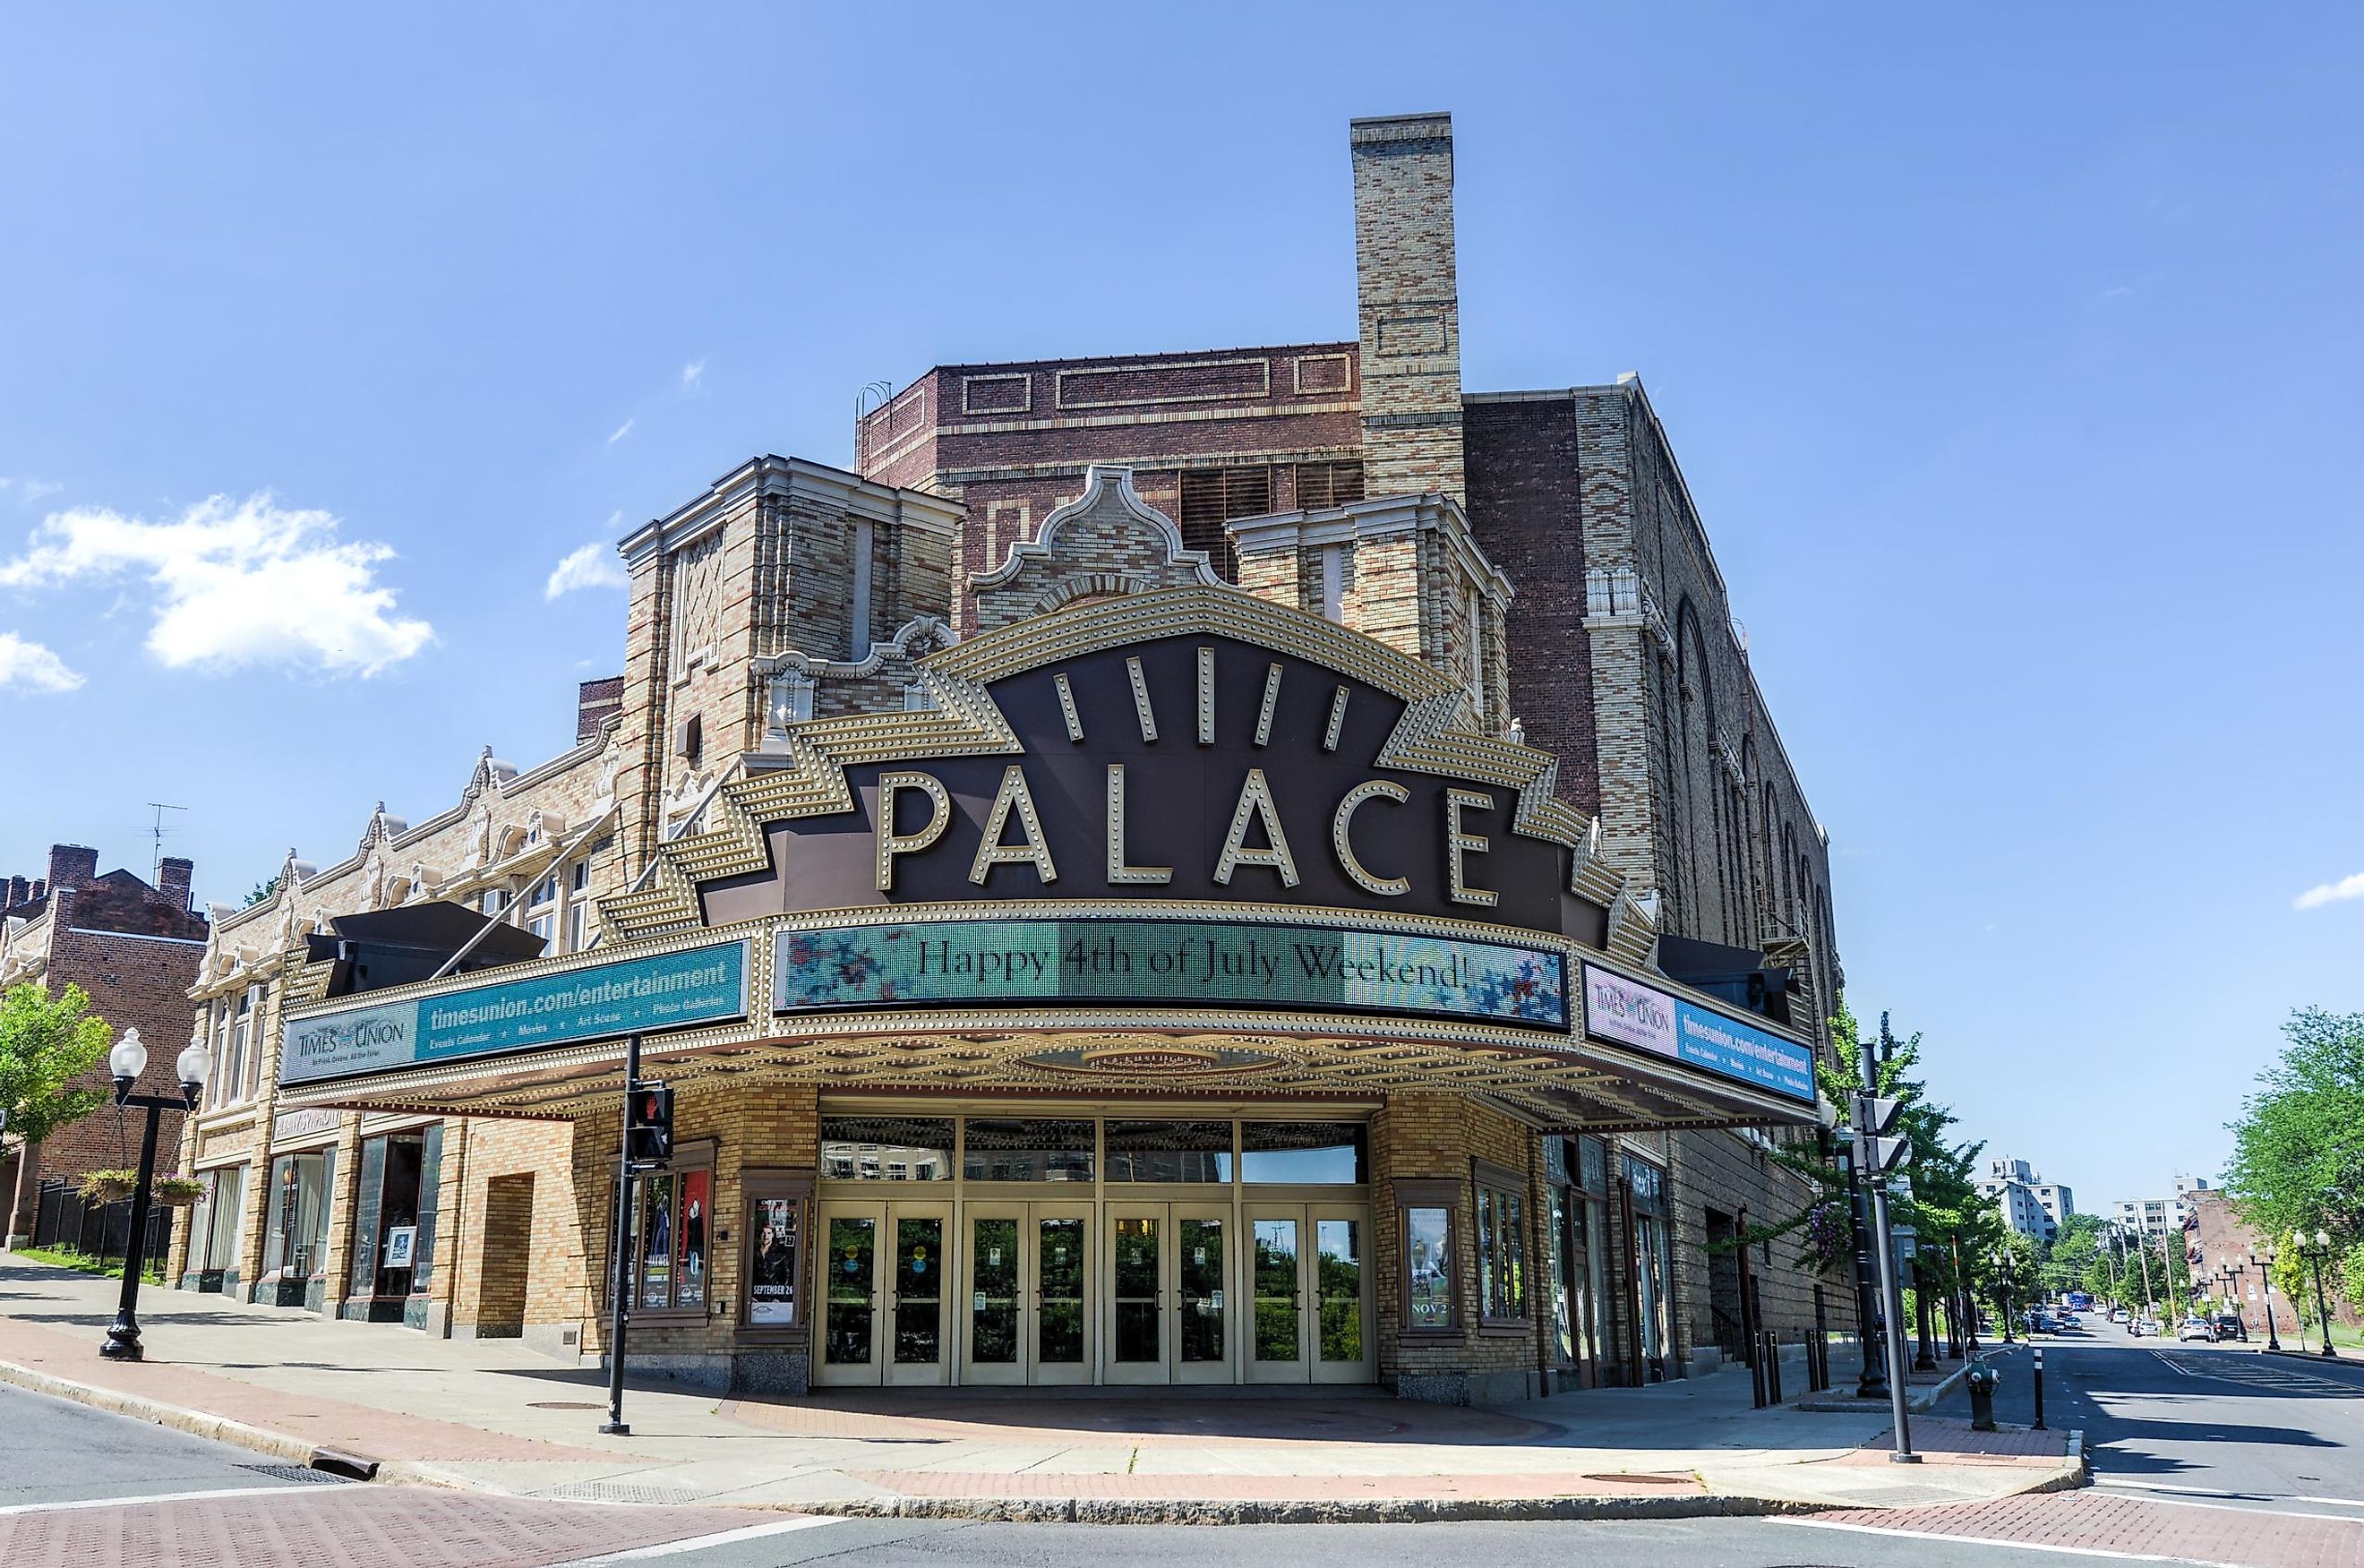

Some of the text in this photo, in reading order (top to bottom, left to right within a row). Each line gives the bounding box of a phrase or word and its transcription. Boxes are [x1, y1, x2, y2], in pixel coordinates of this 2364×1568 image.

[876, 763, 1499, 907] PALACE
[917, 936, 1469, 990] Happy 4th of July Weekend!
[431, 961, 727, 1031] timesunion.com/entertainment
[1595, 984, 1625, 1017] TIMES
[1637, 998, 1669, 1032] UNION
[298, 1023, 404, 1058] TIMES UNION
[1683, 1014, 1808, 1075] timesunion.com/entertainment
[753, 1284, 793, 1295] SEPTEMBER 26
[1412, 1303, 1448, 1314] NOV 2
